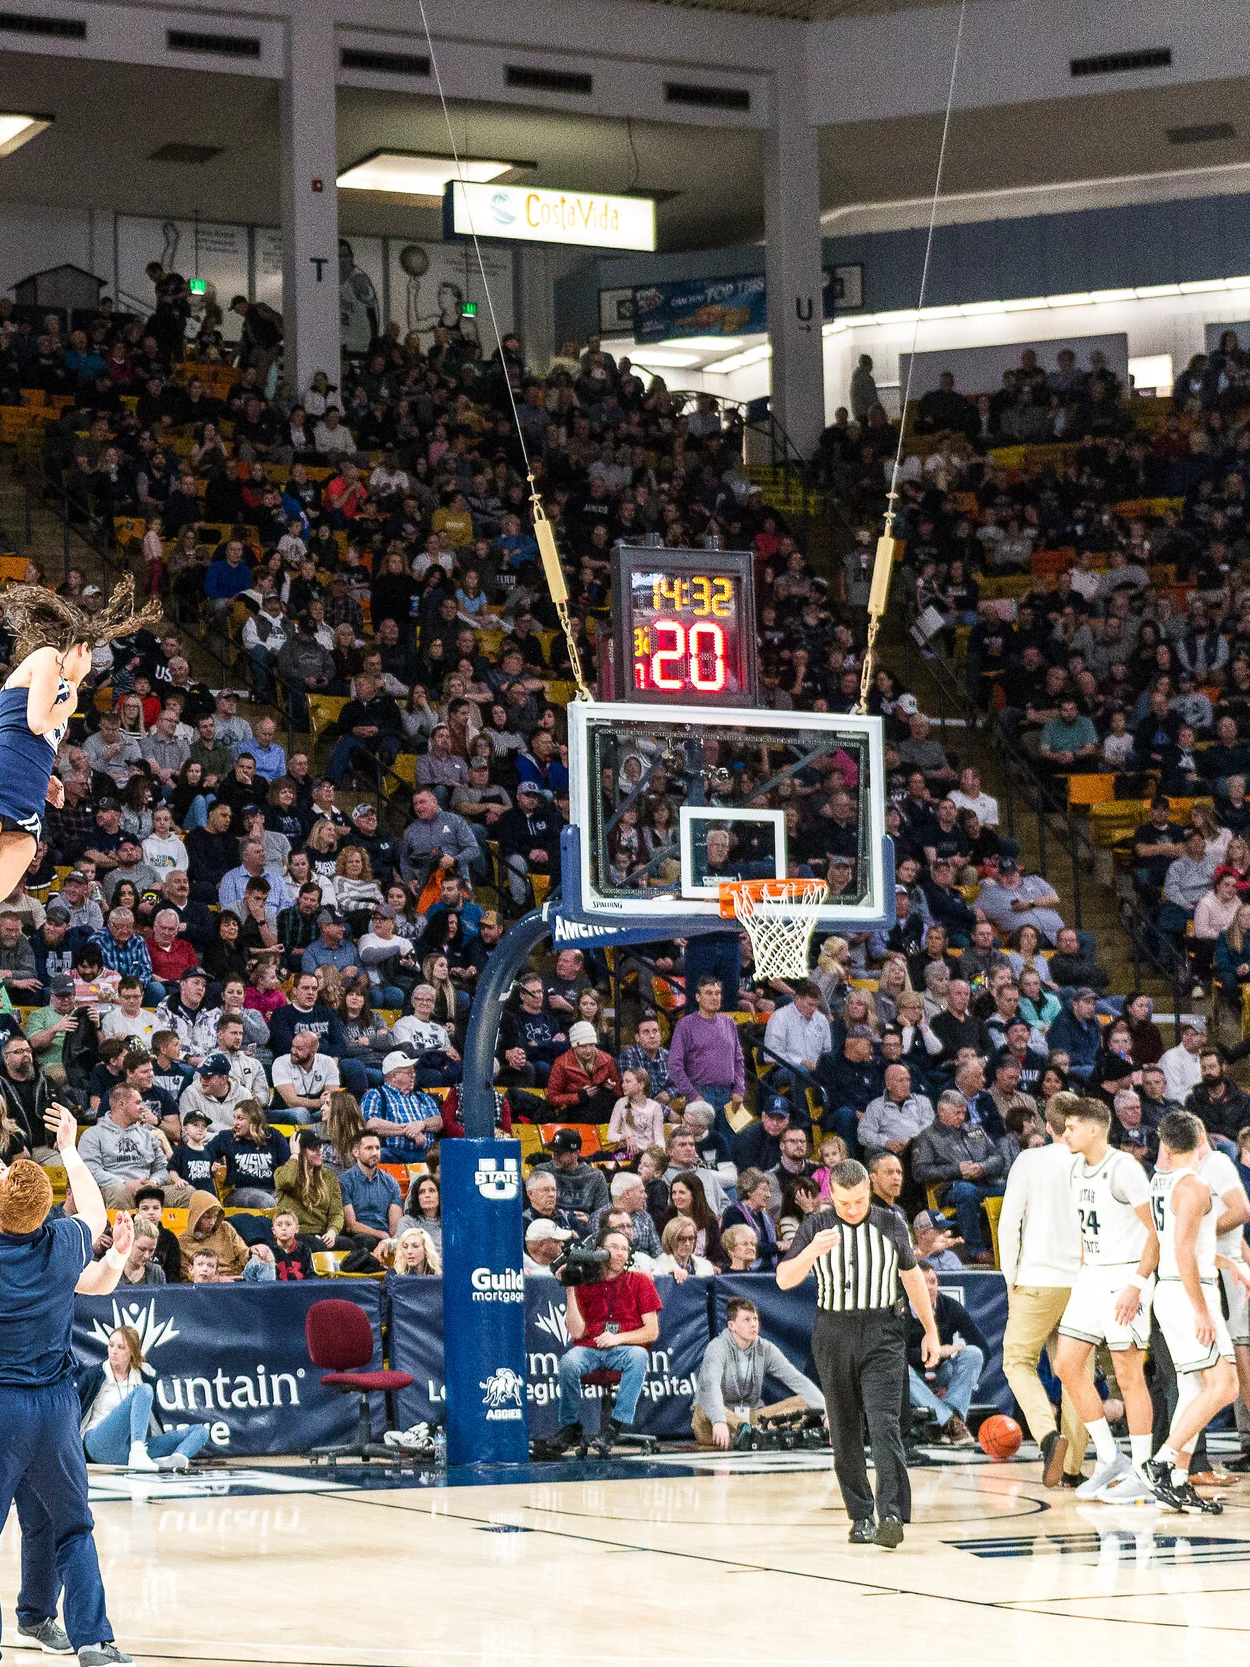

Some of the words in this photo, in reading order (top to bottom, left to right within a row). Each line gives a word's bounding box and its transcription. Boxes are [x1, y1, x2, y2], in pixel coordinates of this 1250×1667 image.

[310, 257, 328, 283] T
[795, 297, 813, 322] U
[652, 576, 734, 618] 14:32
[651, 620, 728, 692] 20
[475, 1170, 519, 1186] STATE
[1077, 1208, 1101, 1236] 24
[1083, 1239, 1101, 1254] TATE
[471, 1267, 525, 1291] Guild
[472, 1291, 524, 1304] mortgag
[155, 1365, 299, 1411] untain
